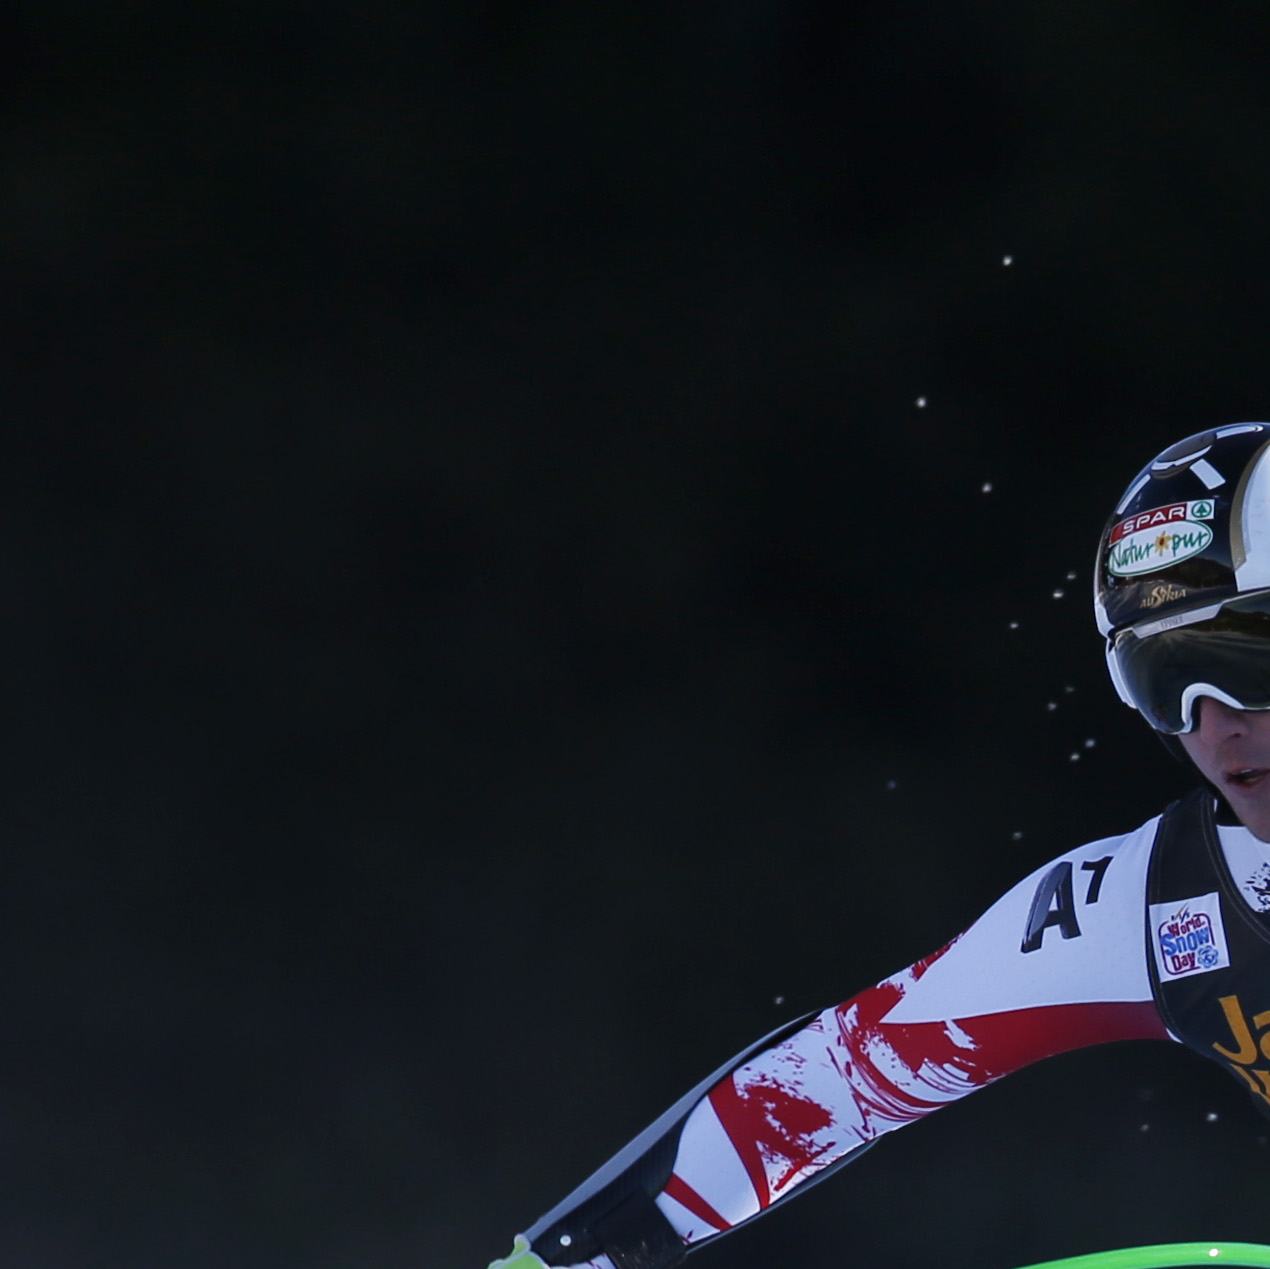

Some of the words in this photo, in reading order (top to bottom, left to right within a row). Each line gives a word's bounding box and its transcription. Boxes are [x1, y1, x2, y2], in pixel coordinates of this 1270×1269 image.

[1123, 506, 1185, 535] SPAR
[1110, 538, 1155, 568] Natur
[1171, 531, 1209, 557] pur
[1020, 856, 1115, 954] A1
[1171, 952, 1196, 972] Day
